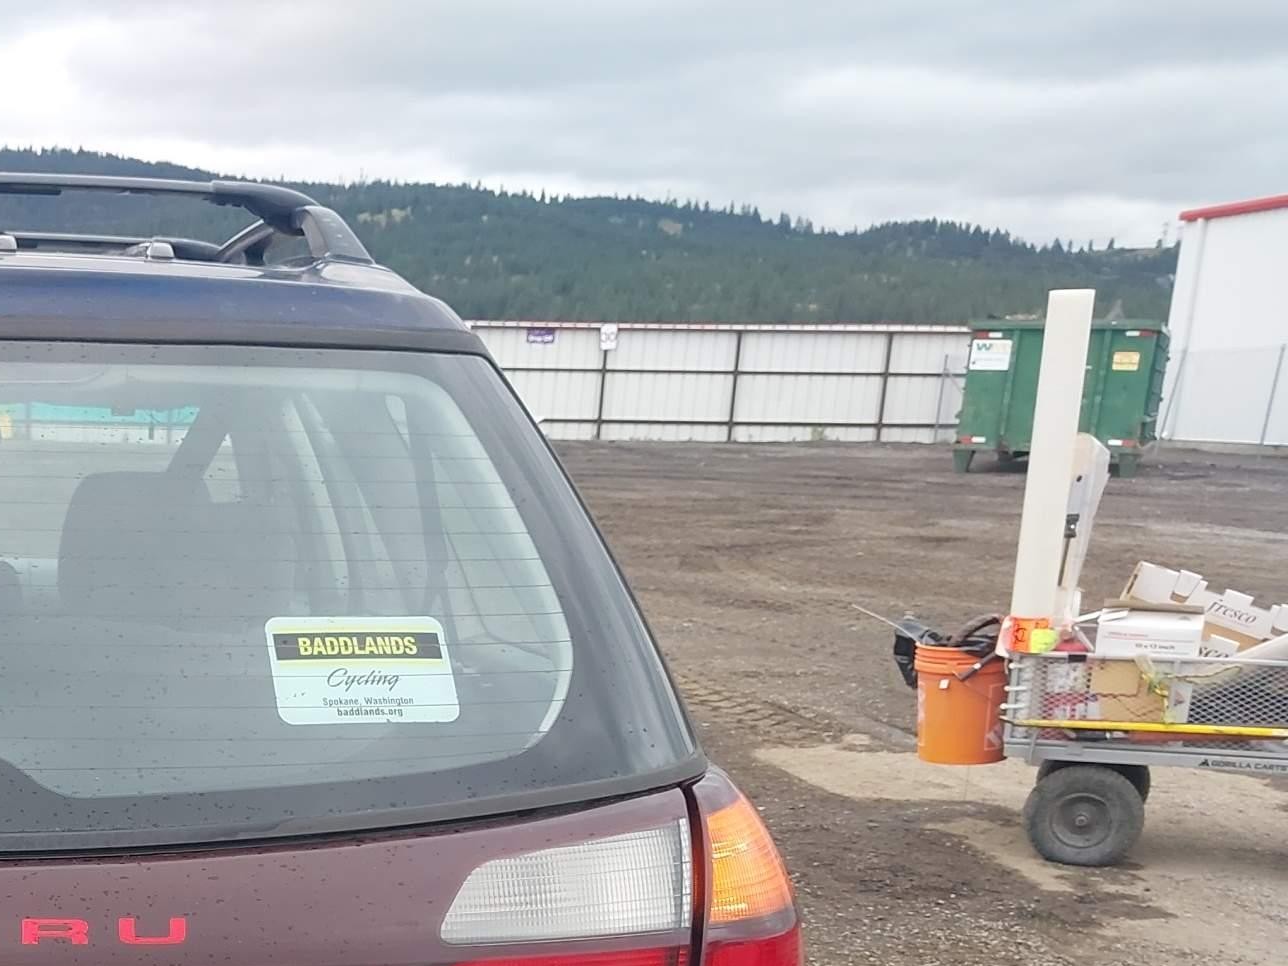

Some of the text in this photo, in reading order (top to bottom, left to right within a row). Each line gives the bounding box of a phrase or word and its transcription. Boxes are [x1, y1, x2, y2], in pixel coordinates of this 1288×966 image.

[297, 637, 418, 656] BADDLANDS
[327, 667, 400, 692] Cycling
[322, 696, 415, 707] Spokane, Washington
[337, 706, 404, 717] baddlands.org
[1211, 760, 1252, 769] GORILLA
